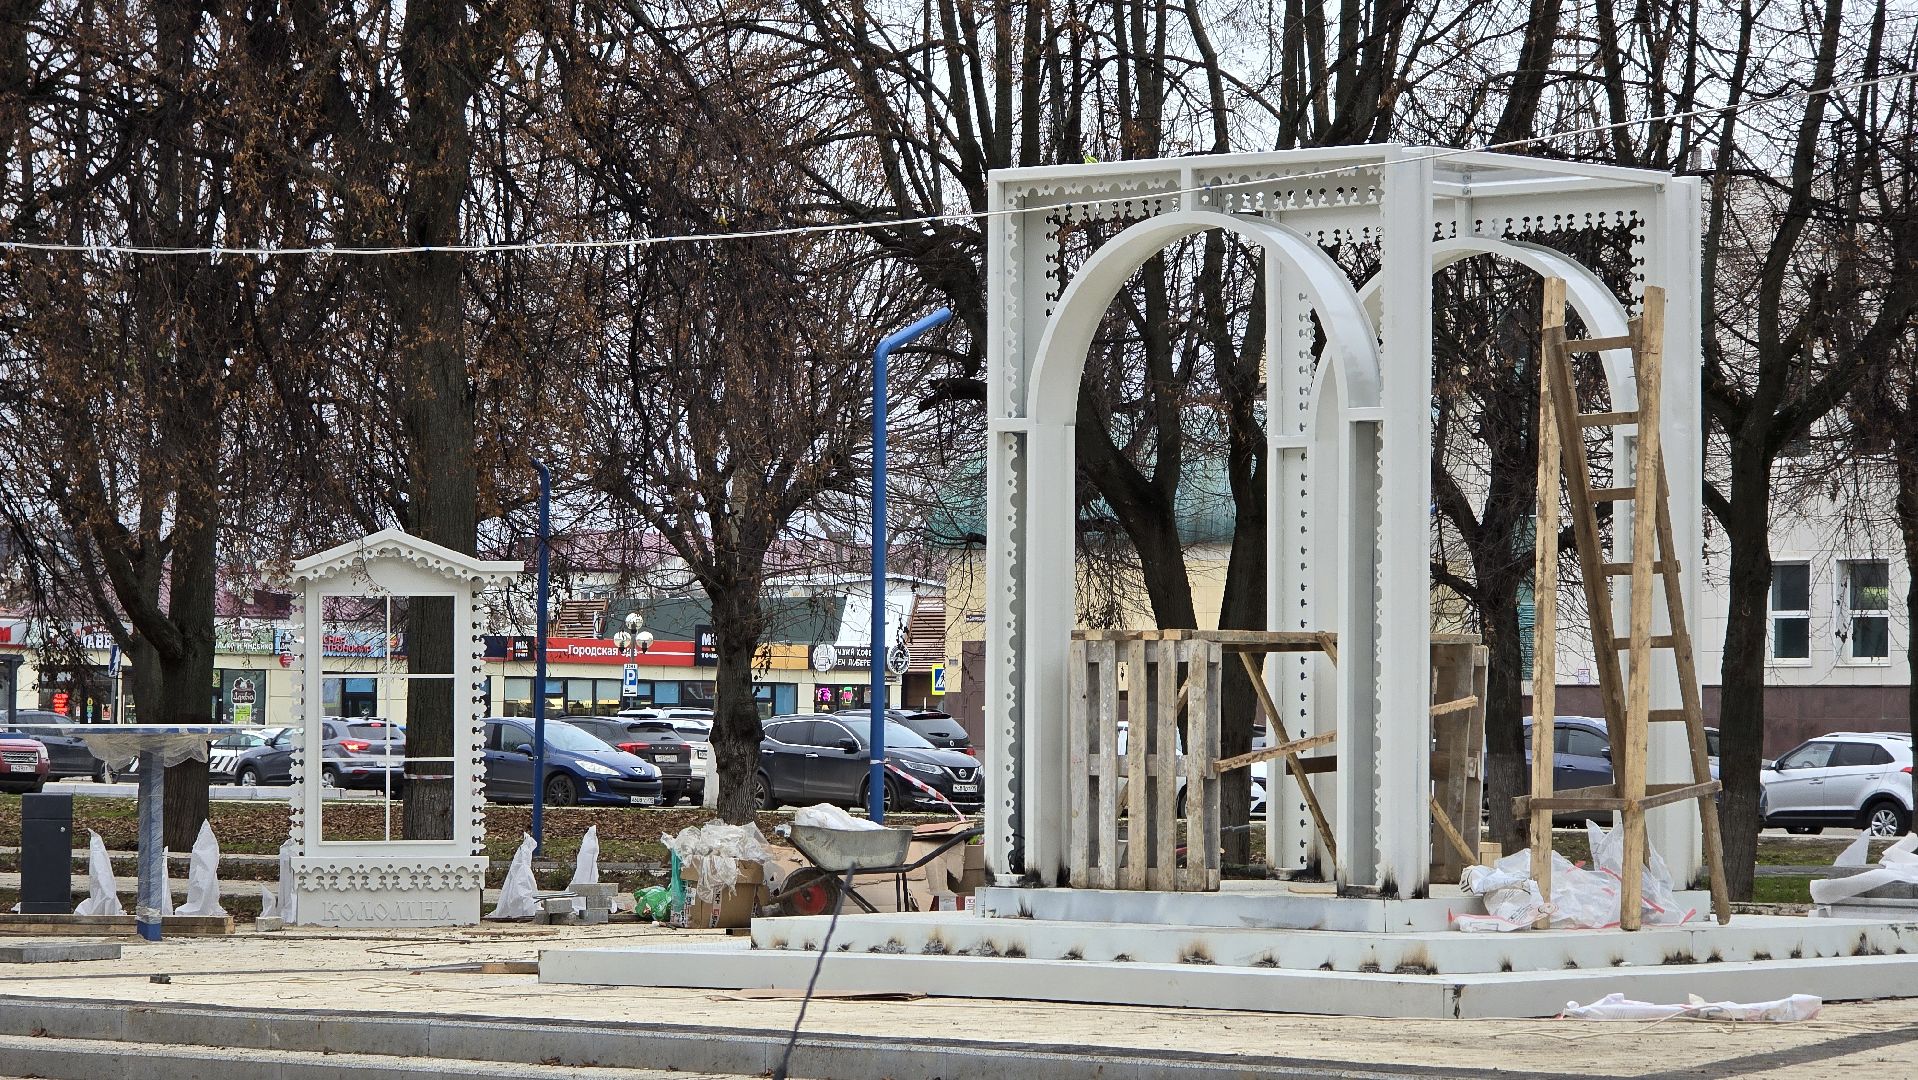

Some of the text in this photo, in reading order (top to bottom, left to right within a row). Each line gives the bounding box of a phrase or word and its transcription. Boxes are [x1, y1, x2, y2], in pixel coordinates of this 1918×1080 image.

[568, 645, 619, 657] Городская
[834, 647, 855, 656] УЧШИЙ
[321, 901, 457, 921] КОЛОМНА
